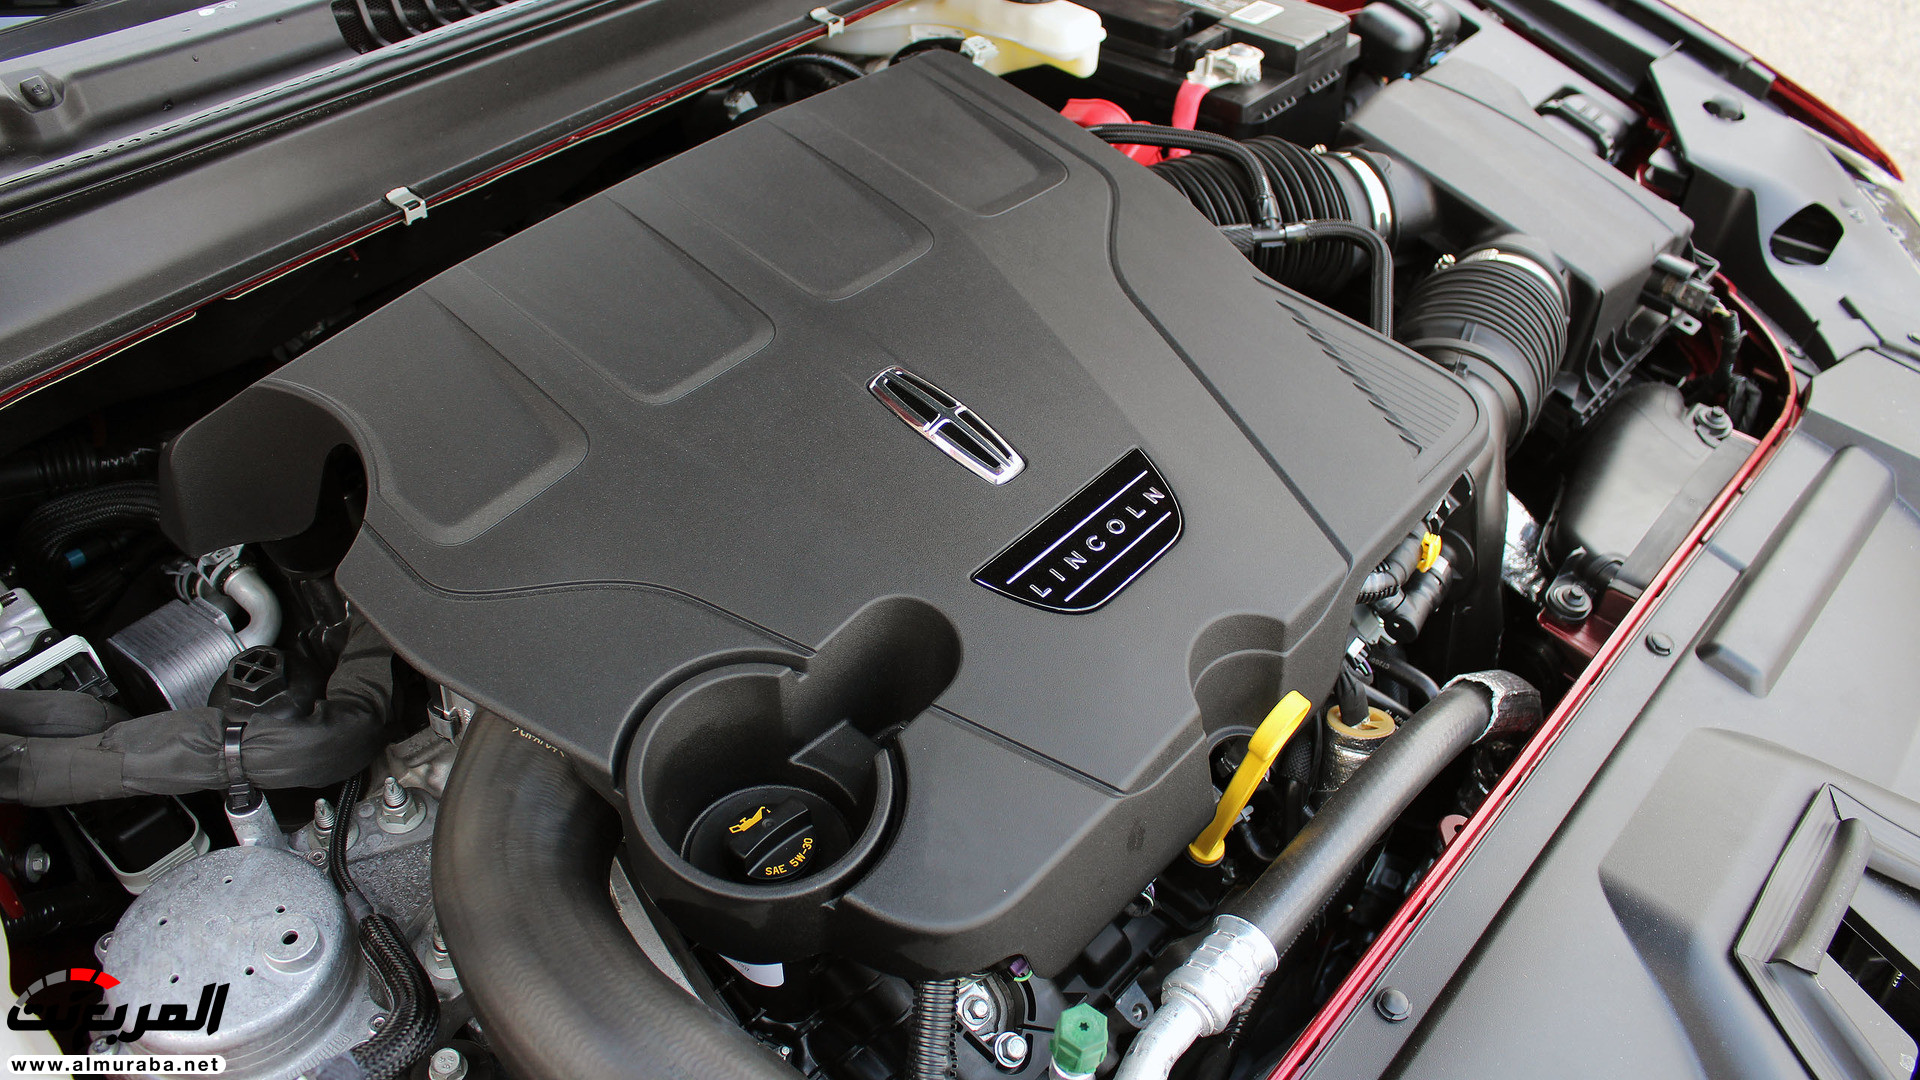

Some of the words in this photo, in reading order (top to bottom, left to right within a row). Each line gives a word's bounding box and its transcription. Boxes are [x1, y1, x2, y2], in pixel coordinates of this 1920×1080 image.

[1029, 486, 1165, 598] LINCOLN
[765, 864, 787, 876] SAE
[789, 837, 813, 868] 5W-30
